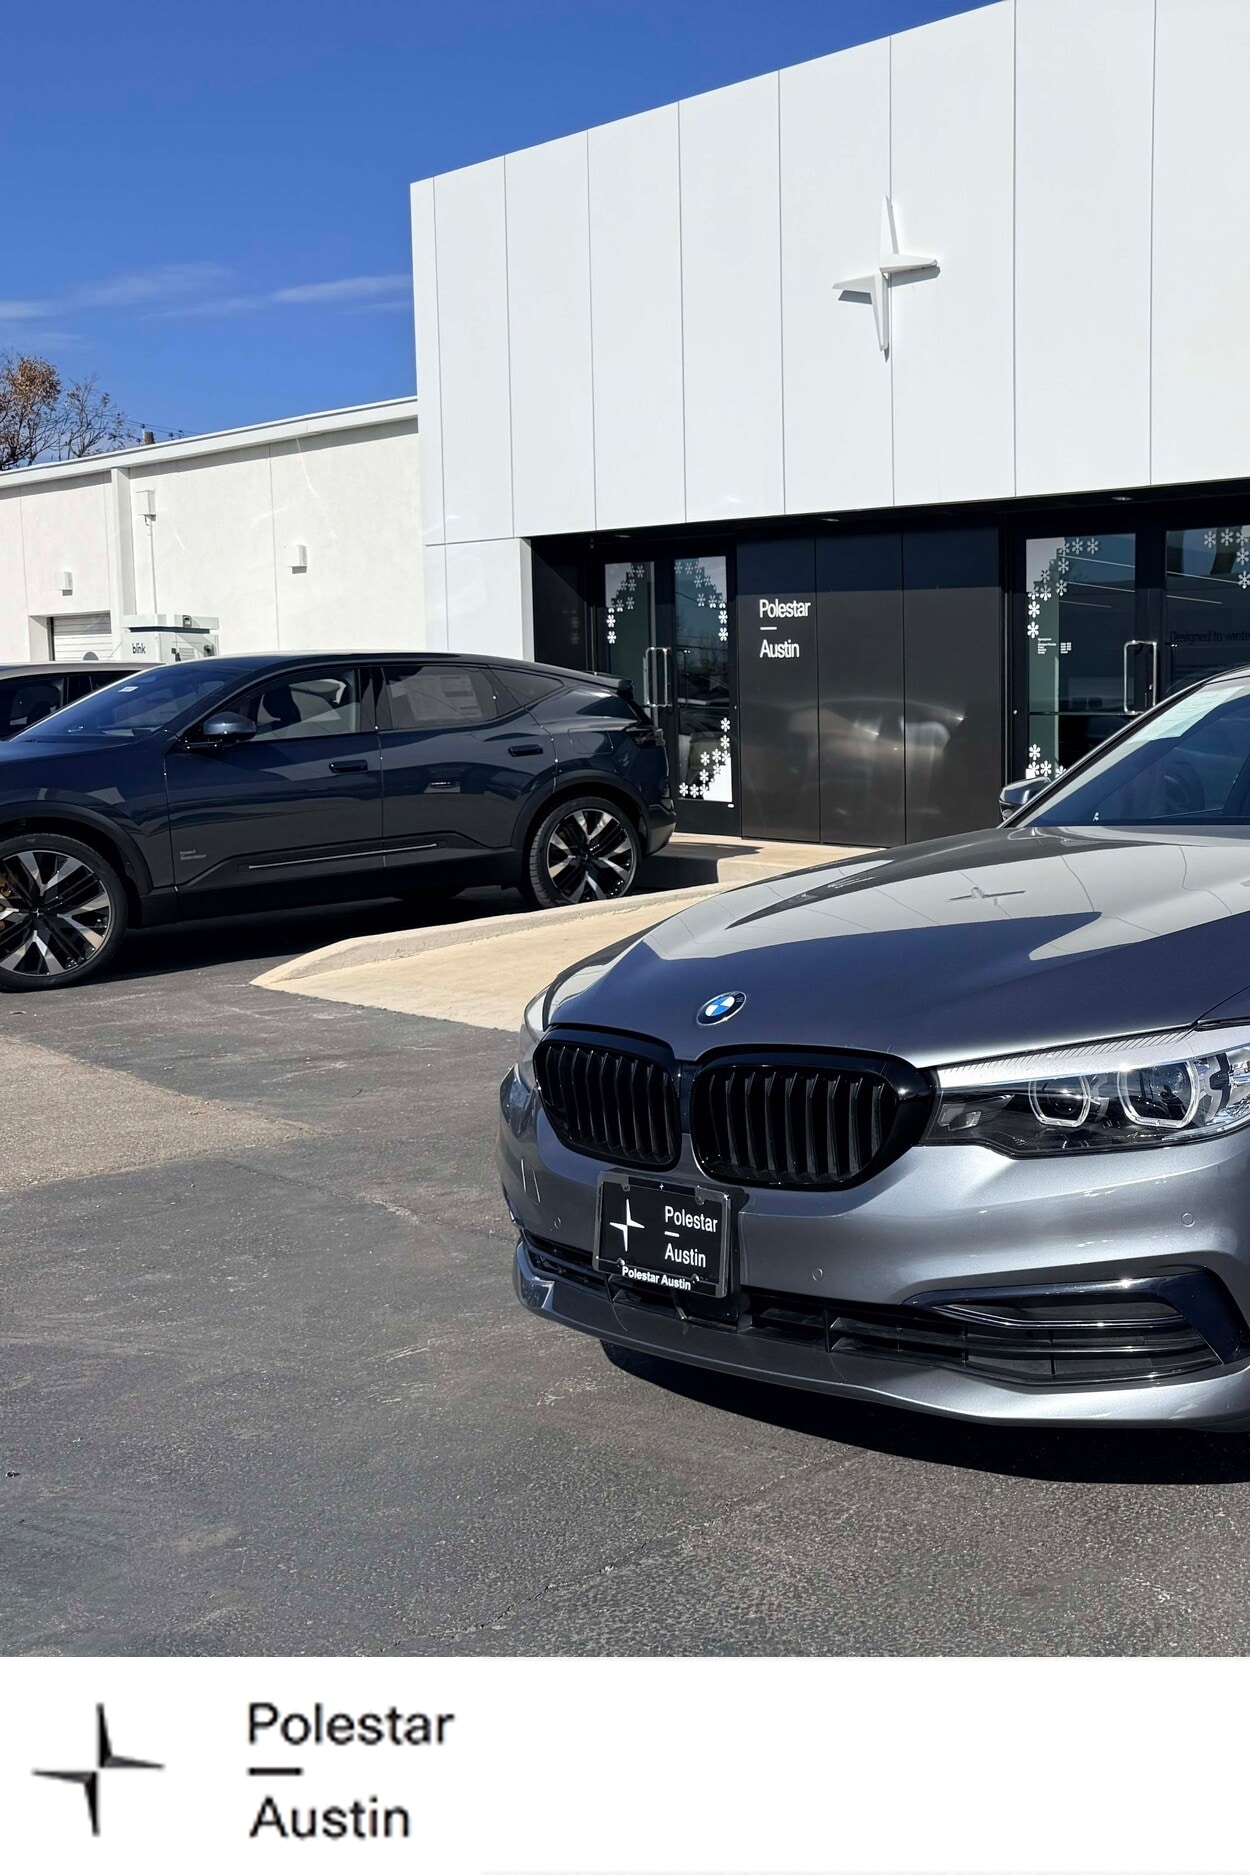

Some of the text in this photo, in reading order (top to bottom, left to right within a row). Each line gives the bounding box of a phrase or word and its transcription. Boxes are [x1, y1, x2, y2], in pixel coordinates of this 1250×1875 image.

[759, 598, 811, 618] Polestar
[759, 639, 800, 658] Austin
[1170, 630, 1211, 645] Designed
[1213, 630, 1223, 641] to
[664, 1205, 718, 1233] Polestar
[664, 1243, 706, 1268] Austin
[622, 1265, 691, 1291] Polestar Austin
